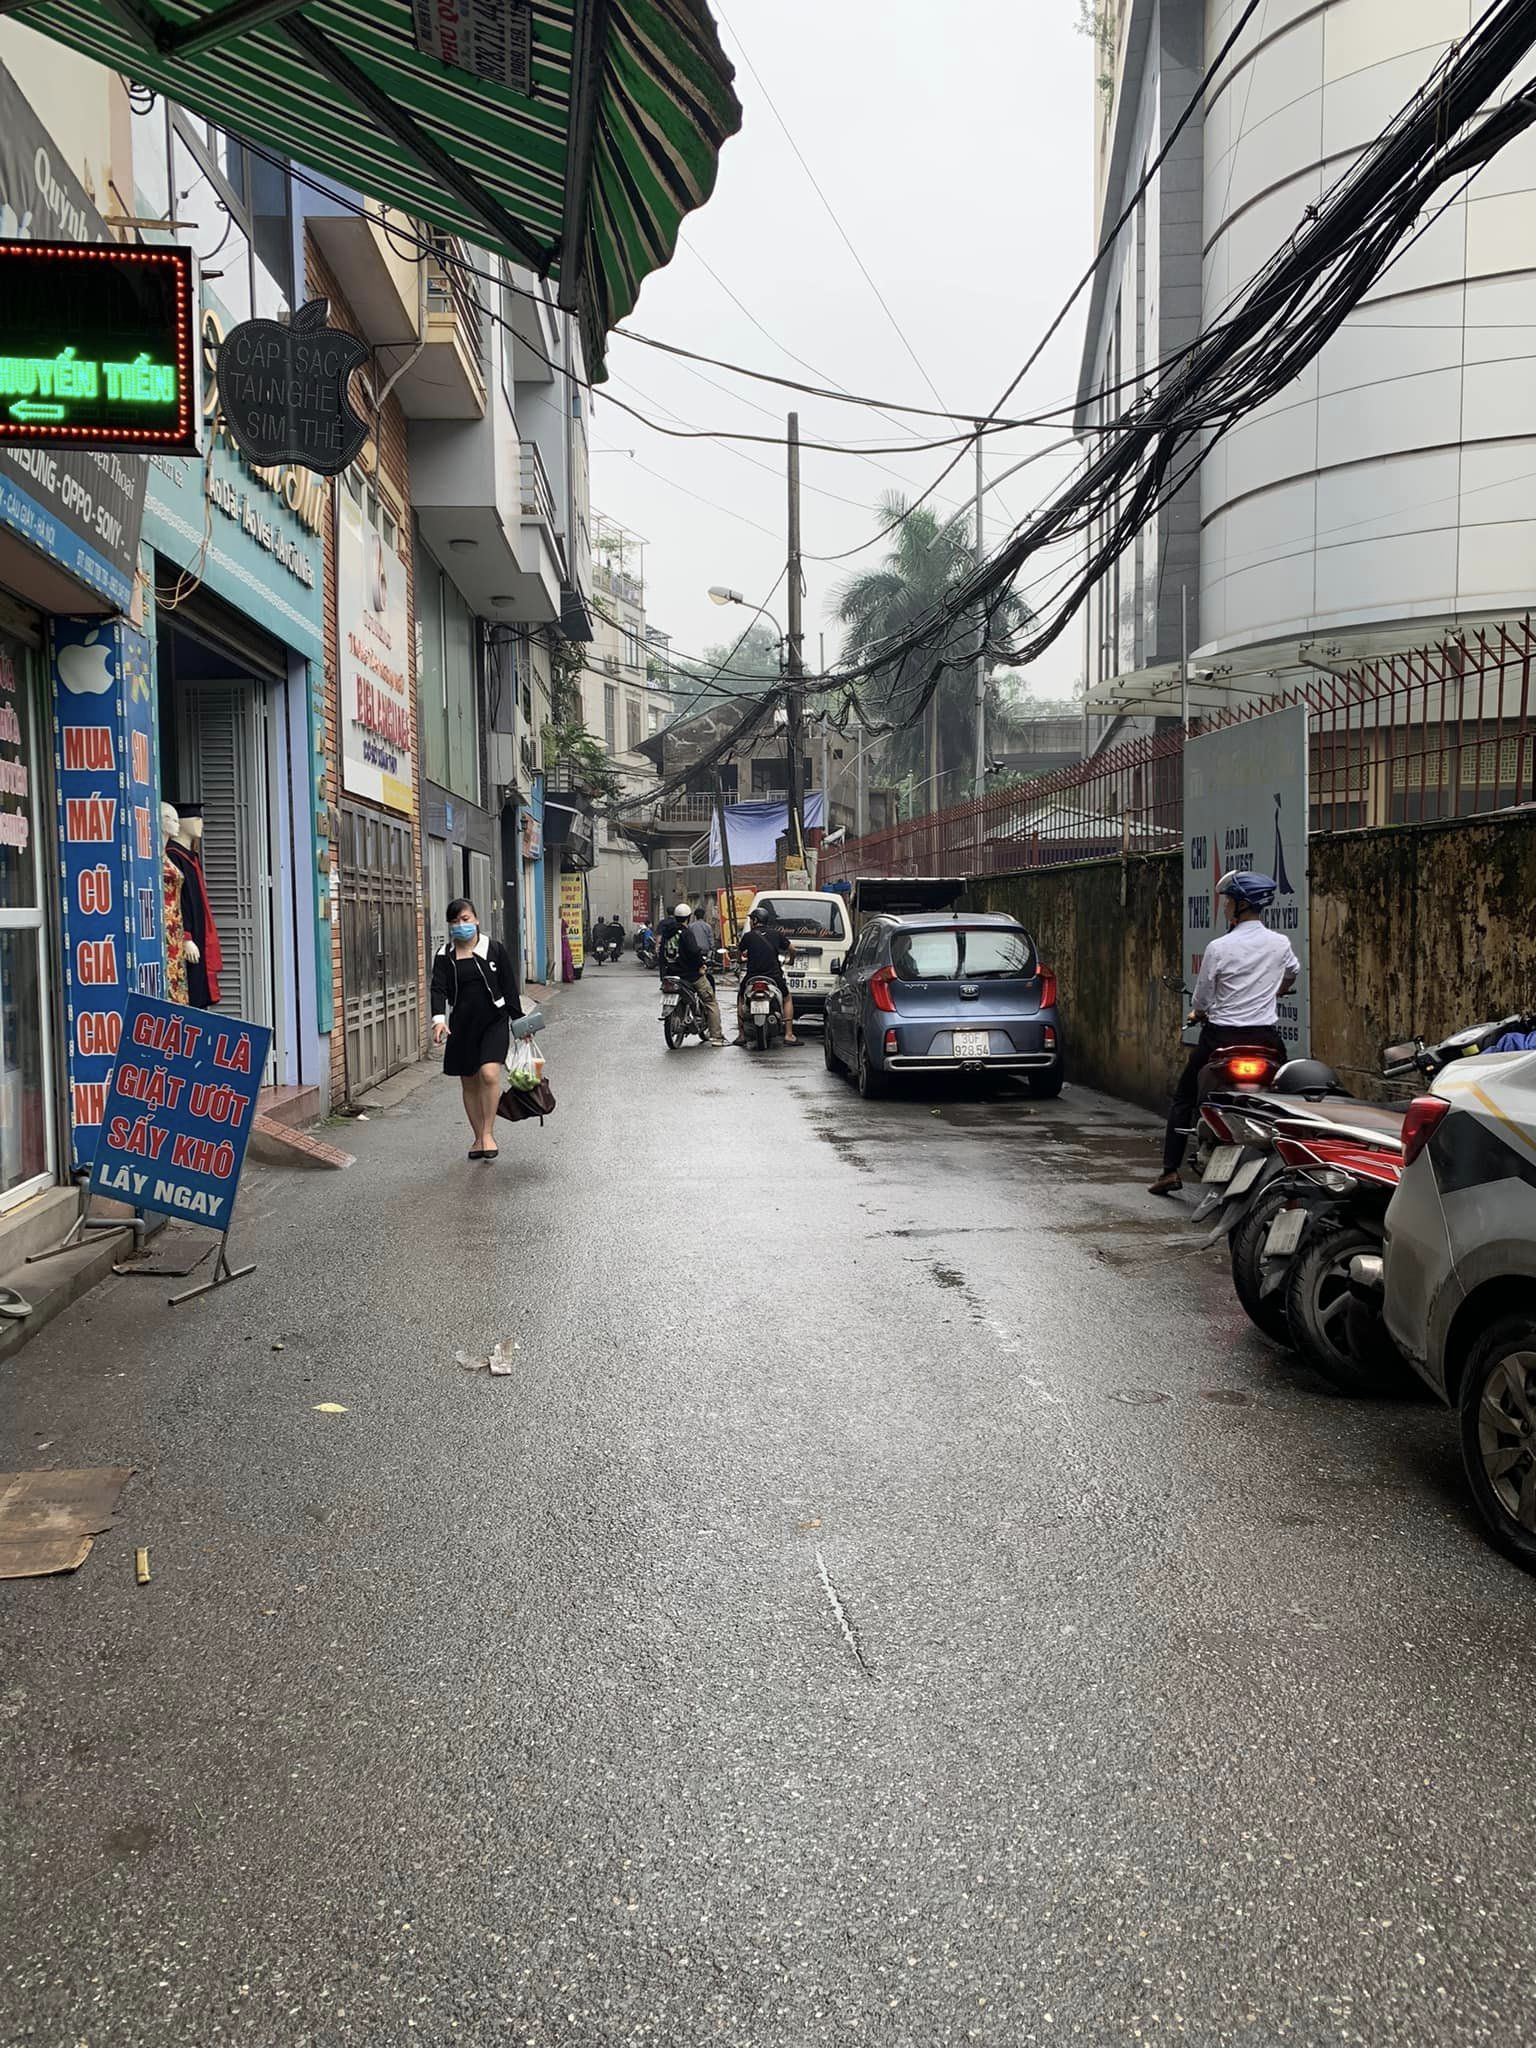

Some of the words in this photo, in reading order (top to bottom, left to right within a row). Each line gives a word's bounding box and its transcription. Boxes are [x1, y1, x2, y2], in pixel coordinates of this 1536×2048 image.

[0, 347, 98, 397] HUYỂN
[270, 376, 336, 412] NGHE
[247, 411, 286, 442] SIM
[62, 474, 92, 523] OPPO
[95, 505, 122, 549] SONY
[63, 726, 116, 771] MUA
[66, 792, 117, 843] MÁY
[1191, 836, 1207, 869] CHO
[78, 863, 112, 915] CŨ
[1188, 889, 1210, 928] THUÊ
[77, 934, 119, 985] GIÁ
[77, 1012, 123, 1056] CAO
[133, 1013, 201, 1060] GIẶT
[214, 1031, 251, 1073] LÀ
[955, 1045, 989, 1057] 928.54
[74, 1068, 113, 1126] NH
[116, 1064, 185, 1111] GIẶT
[189, 1083, 250, 1127] ƯỚT
[107, 1113, 169, 1160] SẤY
[171, 1133, 235, 1180] KHÔ
[99, 1163, 149, 1195] LẤY
[153, 1179, 224, 1217] NGAY
